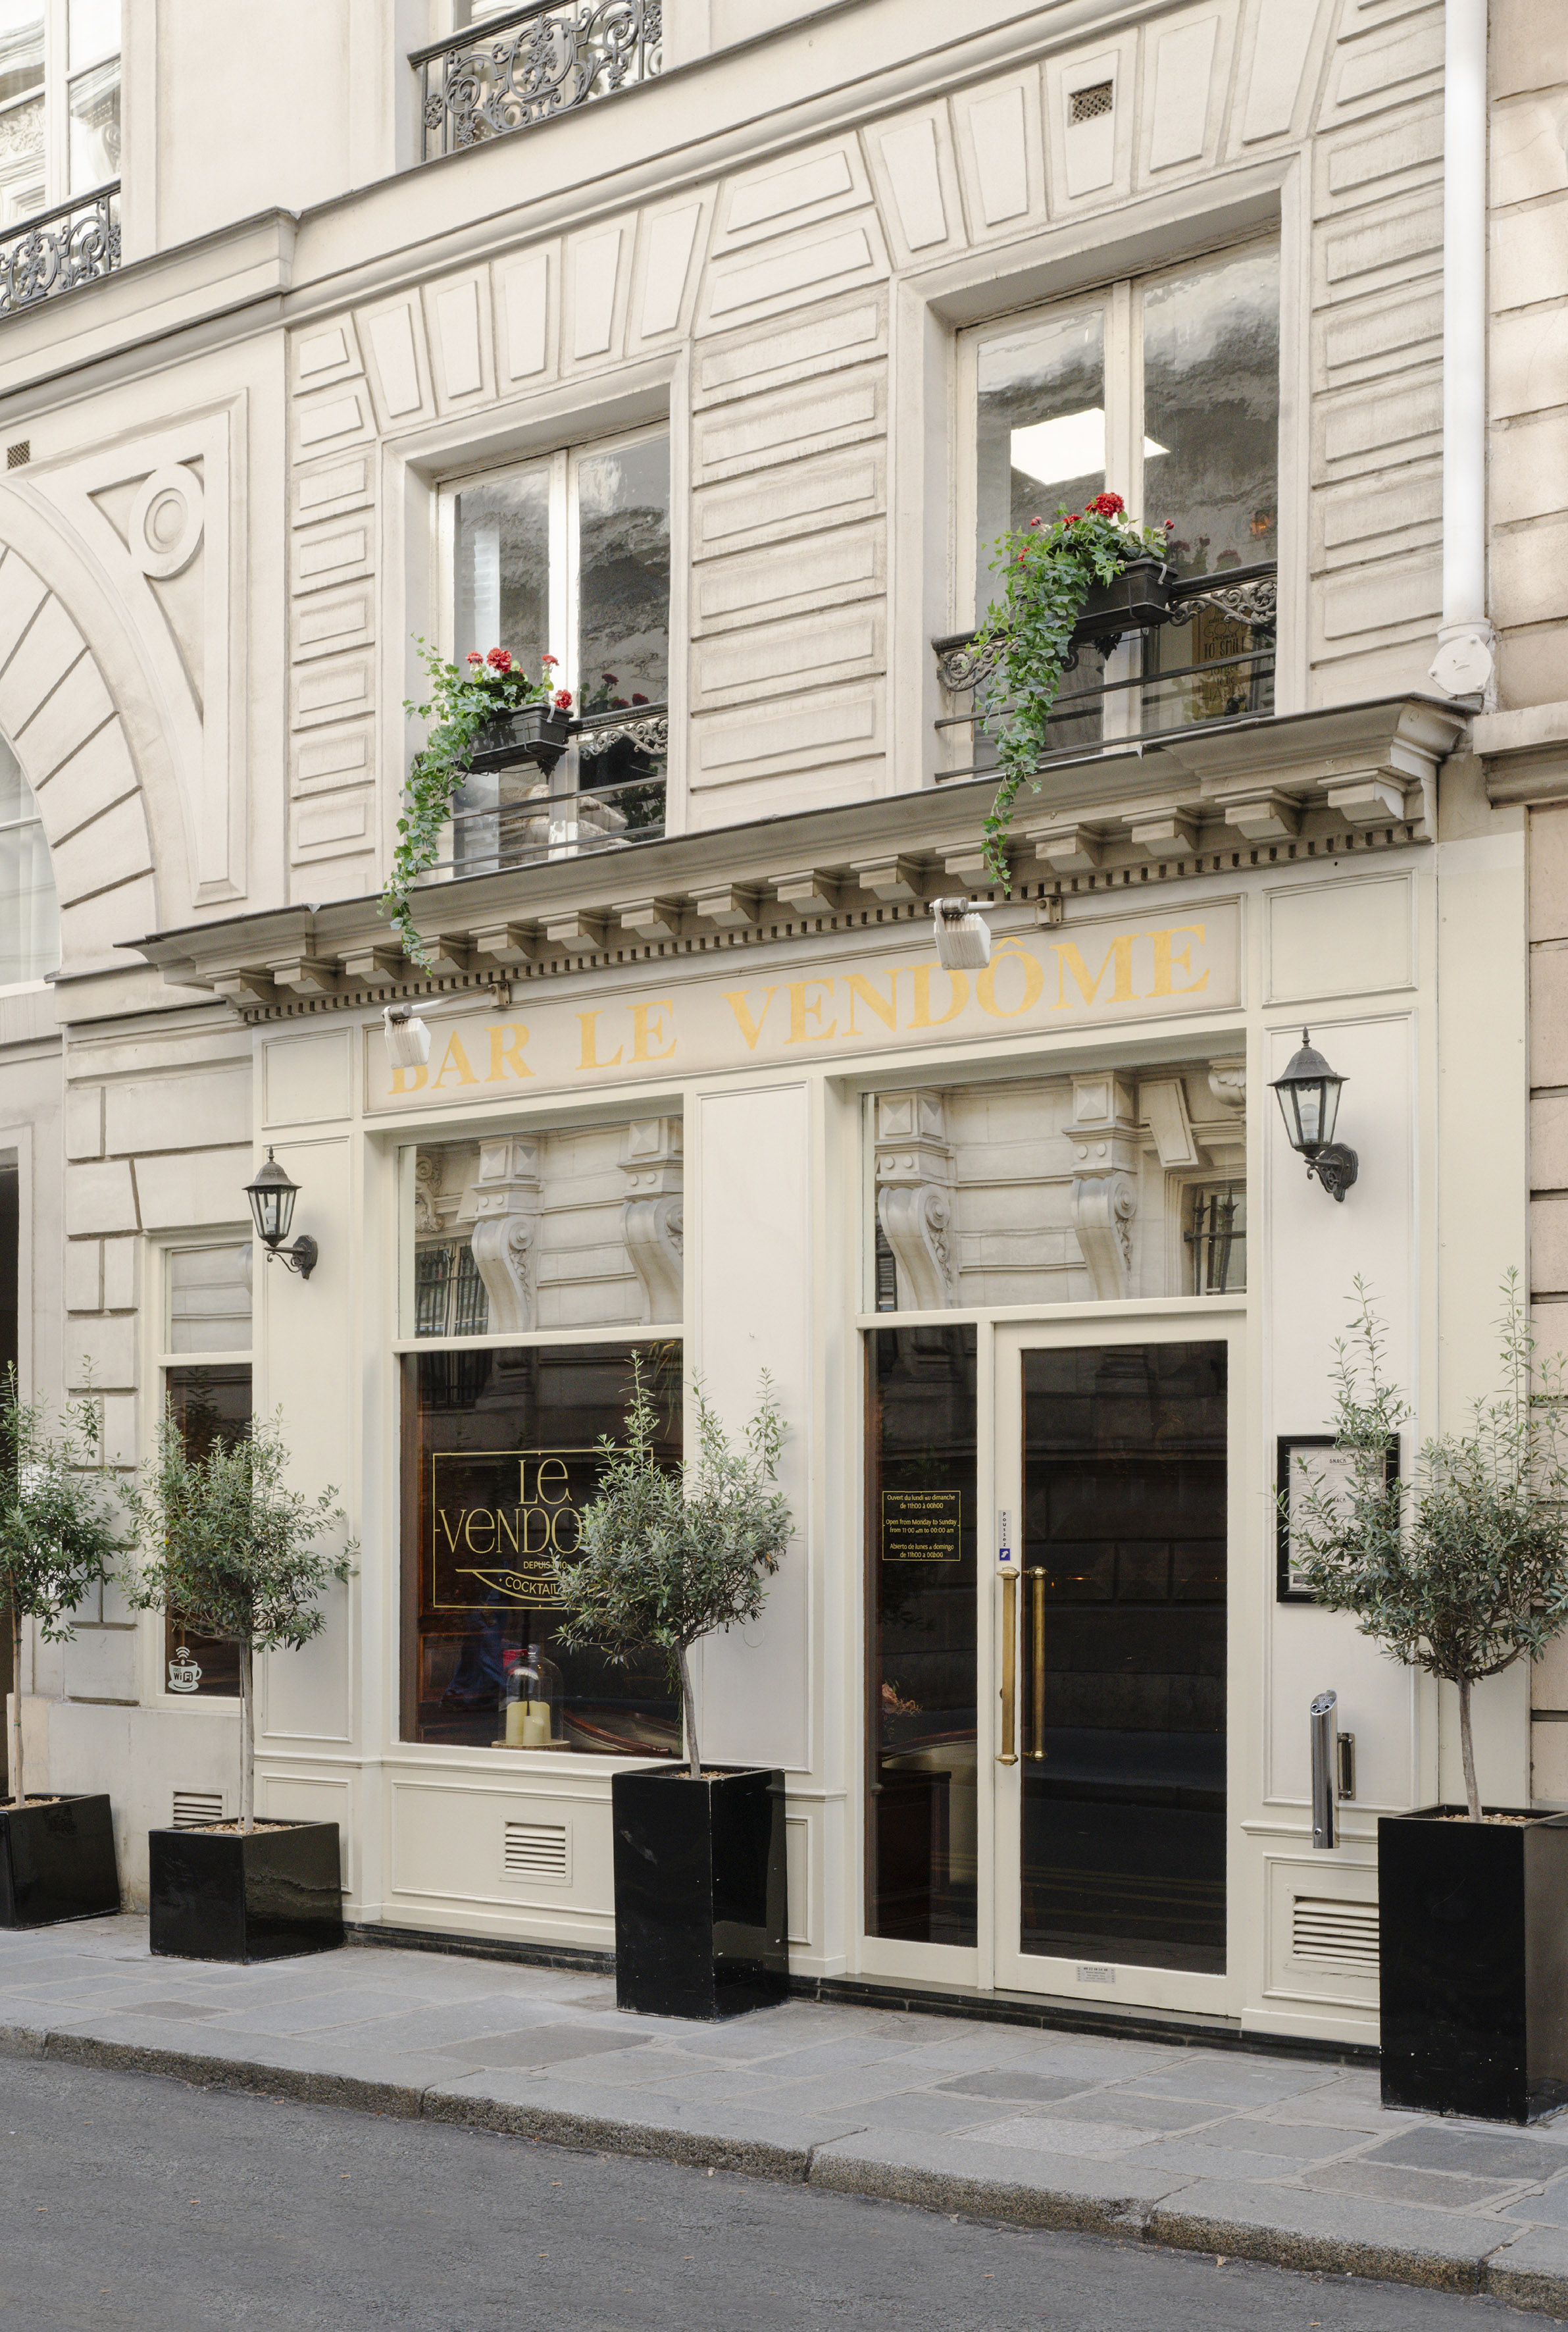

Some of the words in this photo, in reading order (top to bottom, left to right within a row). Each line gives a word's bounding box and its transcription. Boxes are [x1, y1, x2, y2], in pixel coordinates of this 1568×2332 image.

[575, 998, 678, 1071] LE
[721, 923, 1211, 1051] VENDÔME
[438, 1507, 586, 1554] VeNDO
[933, 1543, 954, 1551] domingo
[523, 1561, 550, 1569] DEPUIS
[551, 1561, 567, 1569] 110
[505, 1576, 565, 1595] COCKTAIL
